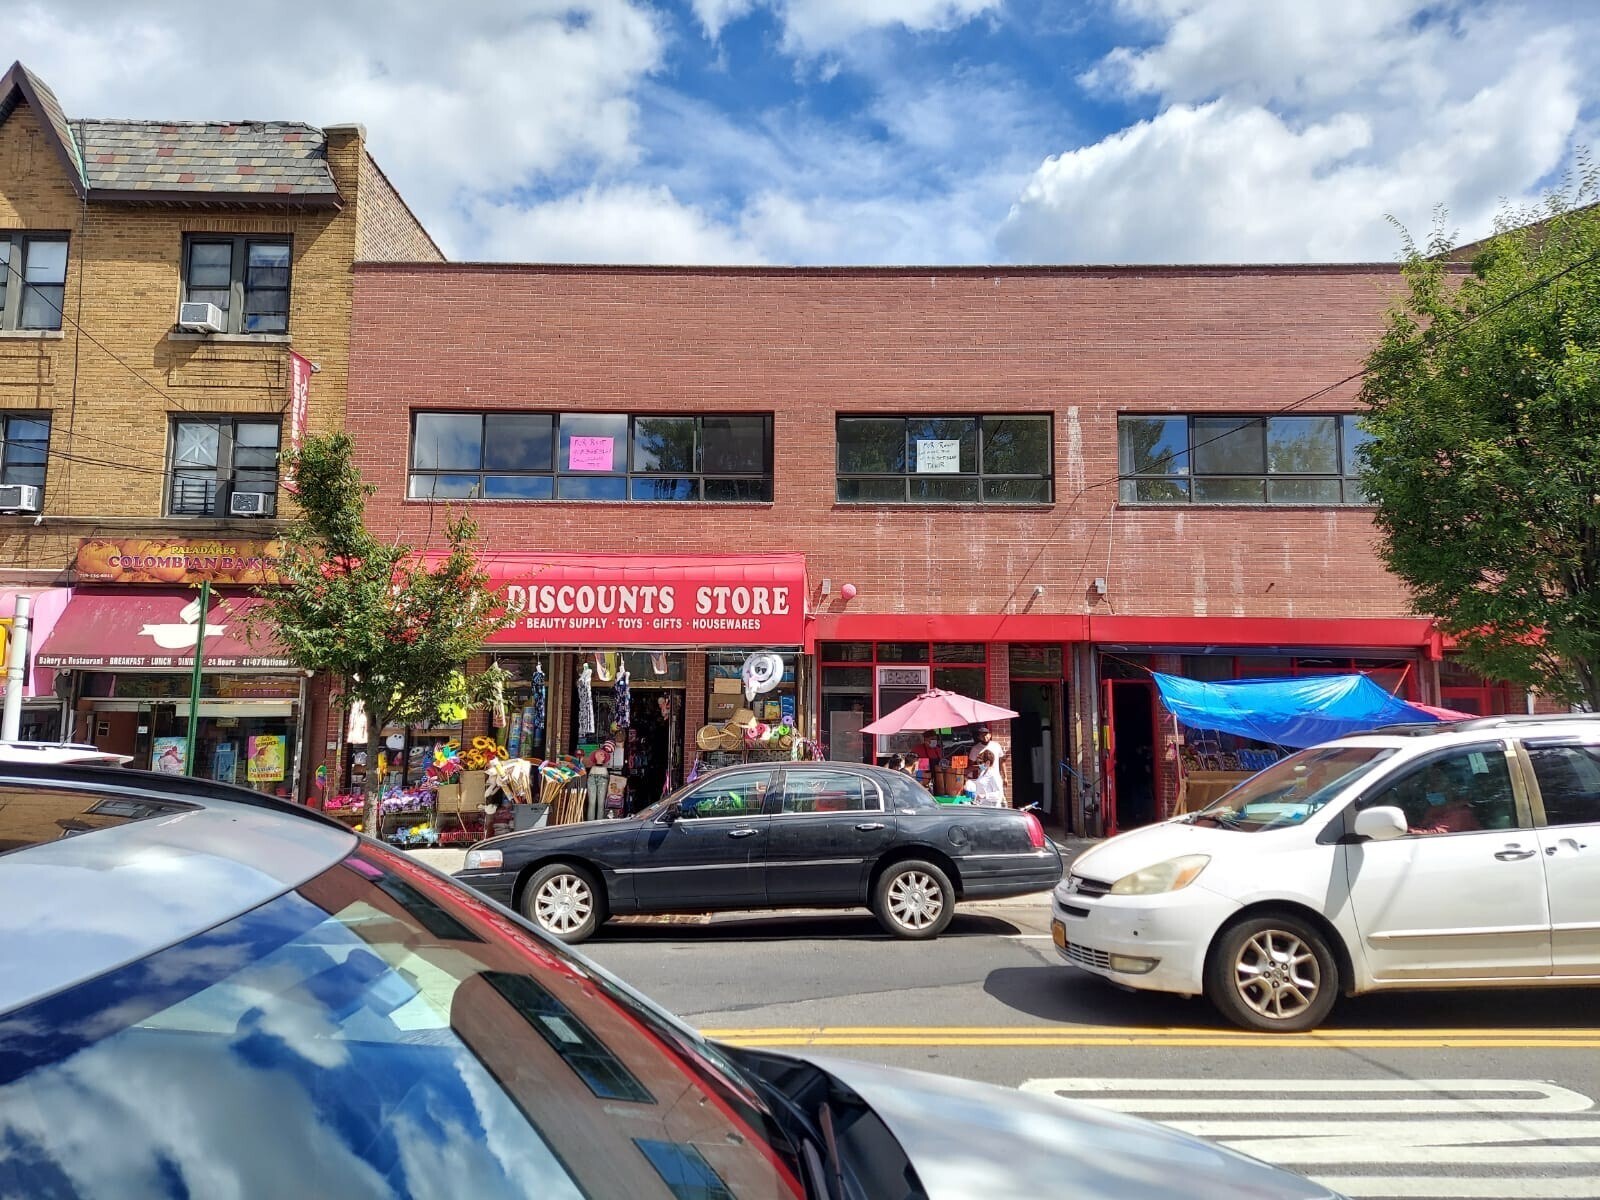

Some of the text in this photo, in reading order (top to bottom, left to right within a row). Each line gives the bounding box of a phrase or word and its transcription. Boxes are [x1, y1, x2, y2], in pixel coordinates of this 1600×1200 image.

[108, 555, 218, 570] COLOMBIAN
[506, 585, 675, 614] DISCOUNTS
[695, 586, 790, 615] STORE
[526, 617, 567, 629] BEAUTY
[568, 617, 608, 629] SUPPLY
[617, 618, 643, 629] TOYS
[653, 618, 682, 629] GIFTS
[692, 618, 761, 630] HOUSEWARES
[38, 656, 61, 667] Bakery
[68, 656, 104, 665] Restaurant
[109, 656, 145, 666] BREAKFAST
[151, 657, 172, 666] LUNCH
[207, 658, 217, 666] 24
[217, 657, 236, 666] Hours
[242, 658, 261, 666] 41-07
[261, 657, 289, 666] National
